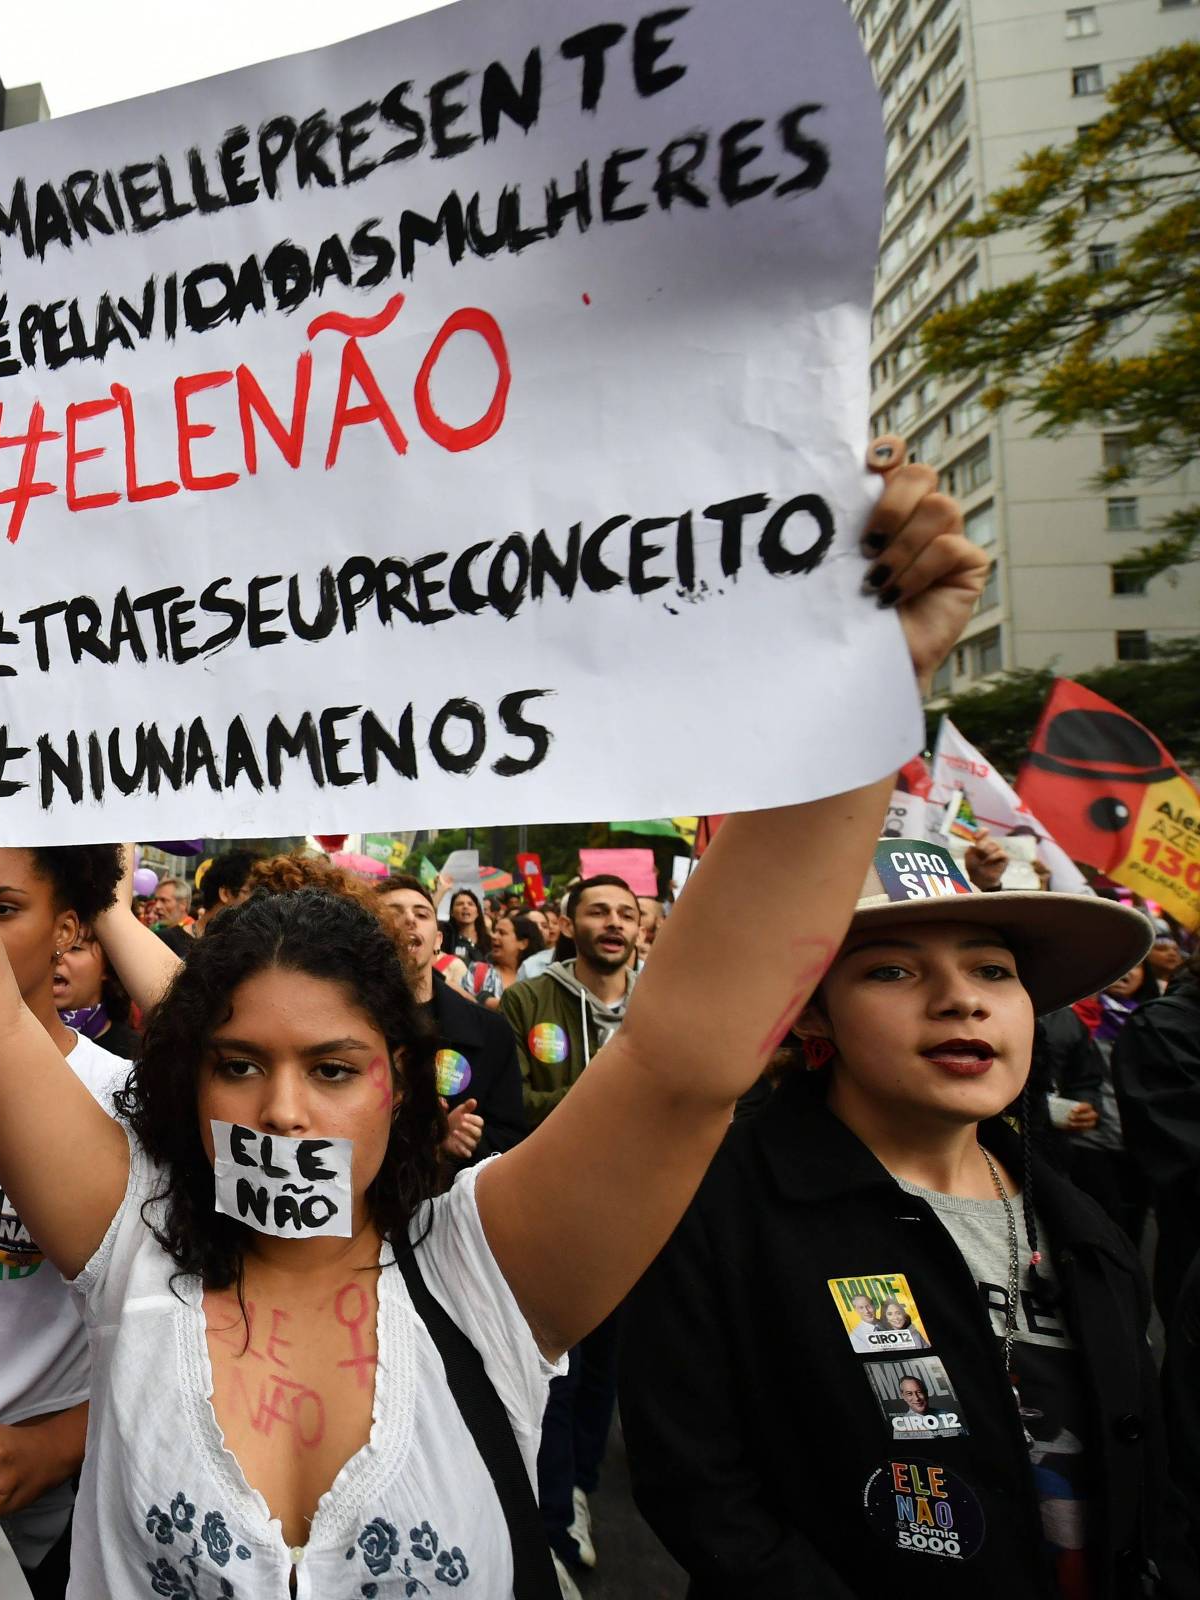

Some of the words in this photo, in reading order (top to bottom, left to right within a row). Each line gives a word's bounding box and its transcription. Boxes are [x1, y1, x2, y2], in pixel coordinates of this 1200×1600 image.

[890, 852, 950, 876] CIRO
[230, 1124, 338, 1181] ELE
[236, 1183, 339, 1231] NÃO
[868, 1333, 898, 1345] CIRO
[898, 1332, 912, 1343] 12
[892, 1414, 939, 1431] CIRO
[939, 1413, 962, 1429] 12
[892, 1462, 948, 1498] ELE
[896, 1495, 953, 1529] NÃO
[898, 1531, 961, 1555] 5000
[910, 1522, 959, 1540] Sâmia
